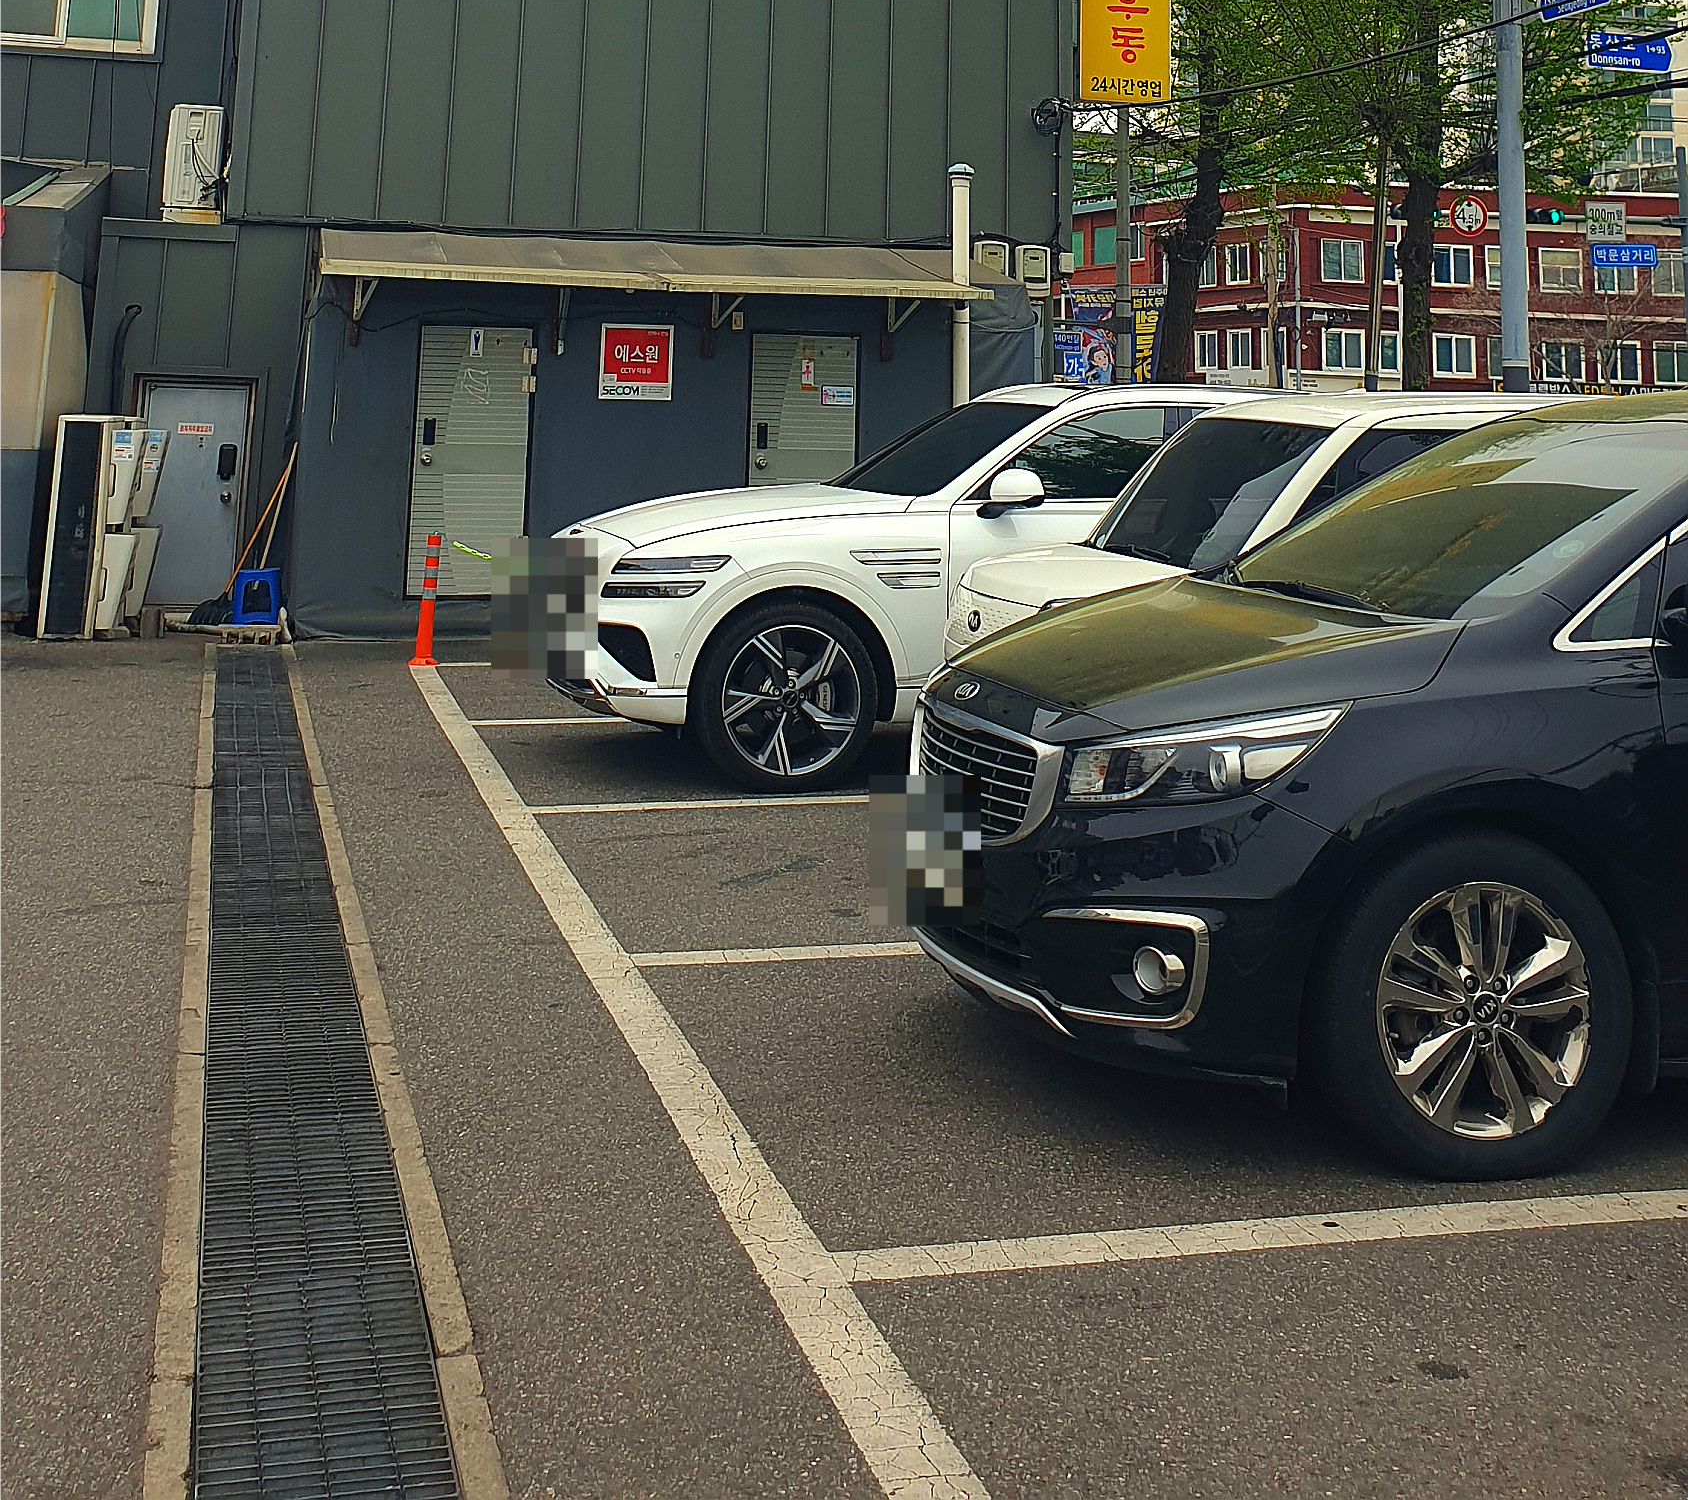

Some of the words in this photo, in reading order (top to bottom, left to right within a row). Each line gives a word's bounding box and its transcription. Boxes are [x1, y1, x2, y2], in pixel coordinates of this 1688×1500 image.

[1591, 53, 1641, 67] Dongsan-ro
[1596, 248, 1654, 262] 박문삼거리
[614, 344, 659, 364] 에스원
[601, 385, 640, 396] SECOM
[1476, 999, 1497, 1018] KIA
